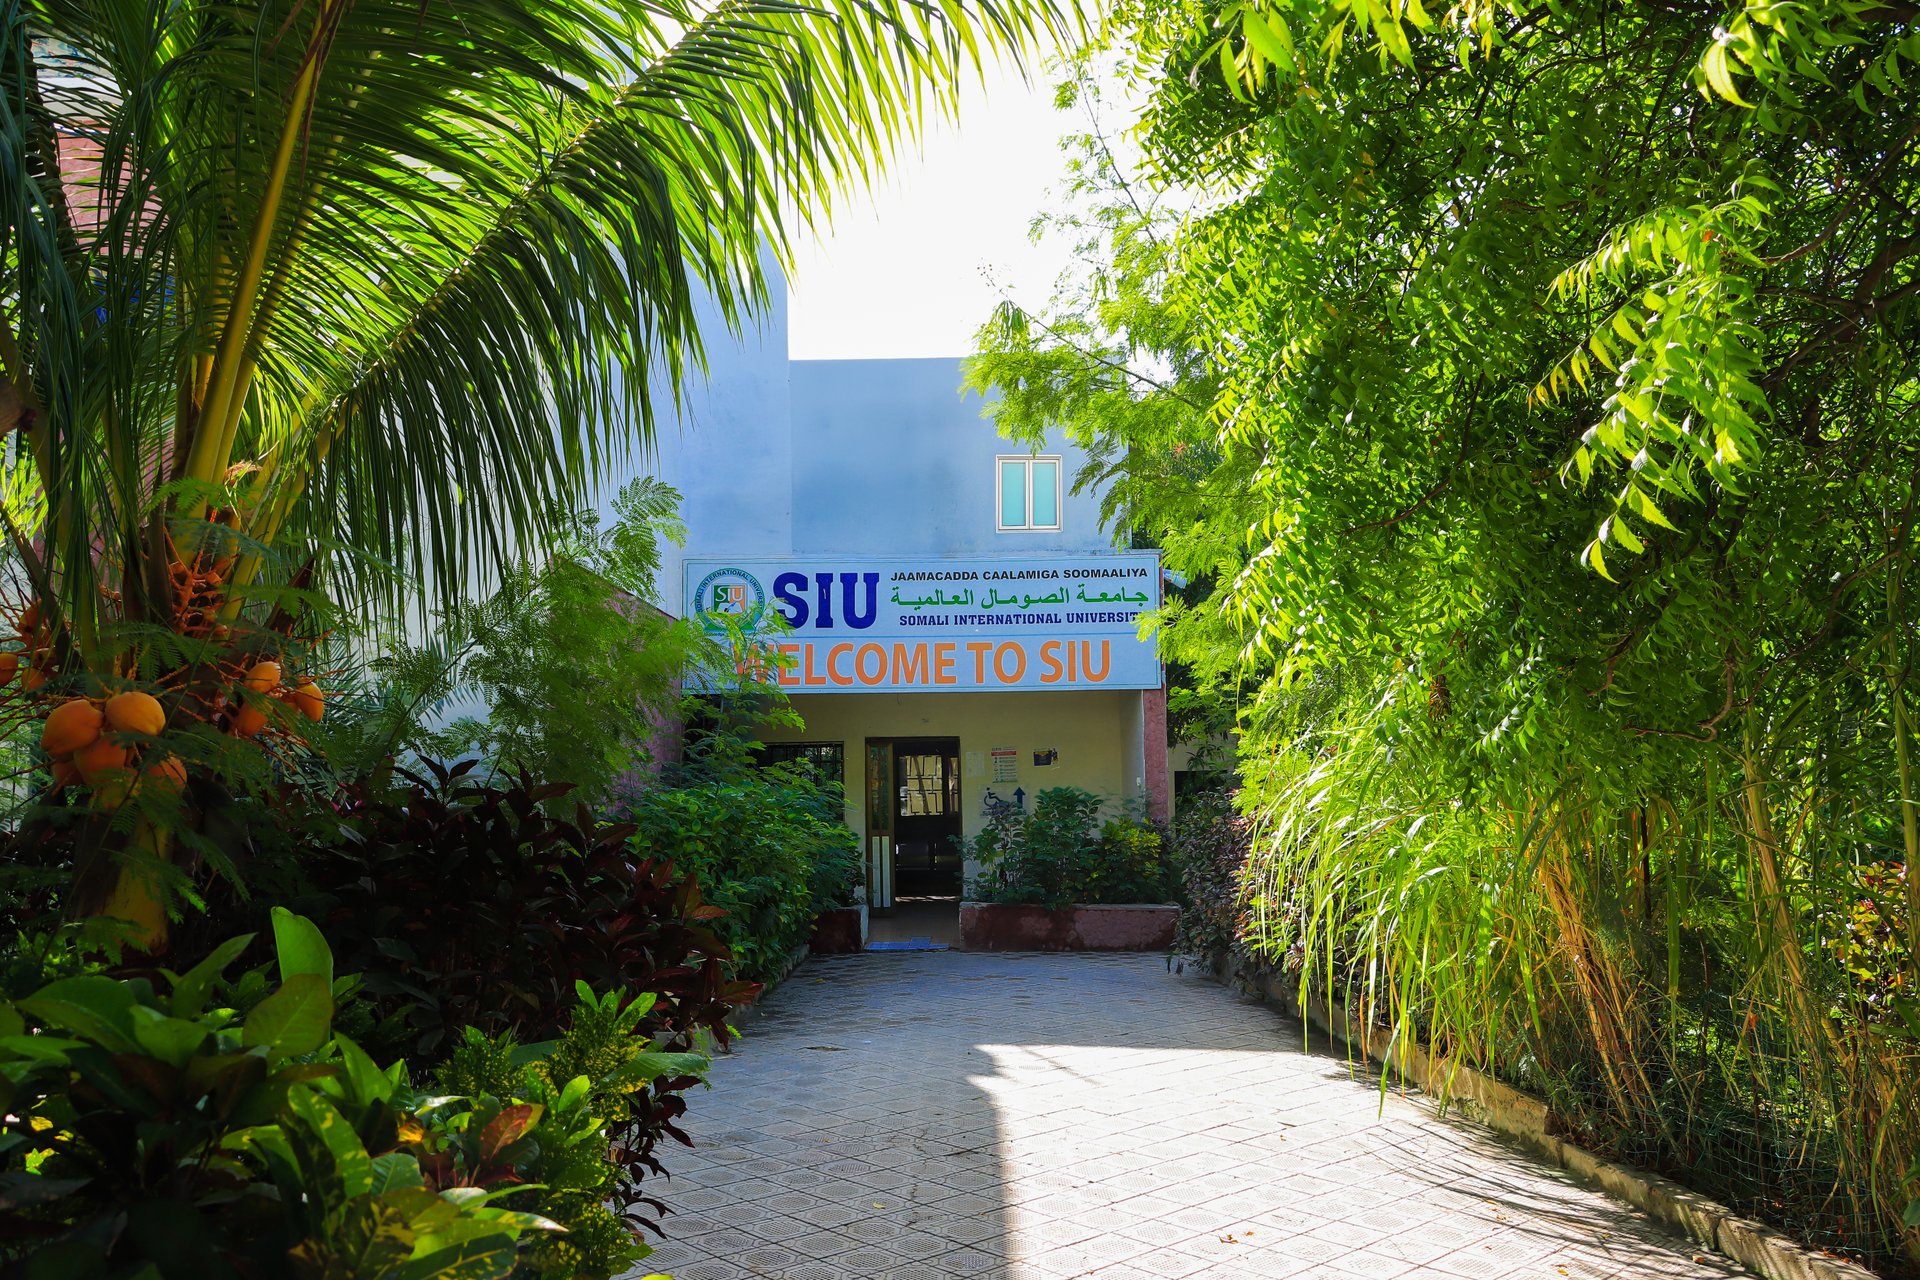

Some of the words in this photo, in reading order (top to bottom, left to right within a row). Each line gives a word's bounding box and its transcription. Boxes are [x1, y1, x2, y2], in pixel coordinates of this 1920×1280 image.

[701, 569, 750, 589] INTERNATIONAL
[891, 571, 979, 582] JAAMACADDA
[983, 570, 1060, 580] CAALAMIGA
[1063, 568, 1148, 579] SOOMAALIYA
[715, 586, 743, 602] SIU
[773, 572, 880, 630] SIU
[890, 586, 974, 611] العالمية
[981, 586, 1070, 609] الصومال
[1076, 583, 1149, 608] جامعة
[899, 615, 950, 626] SOMALI
[954, 613, 1062, 625] INTERNATIONAL
[1066, 611, 1141, 624] UNIVERSIT
[966, 640, 1027, 684] TO
[1039, 639, 1110, 683] SIU
